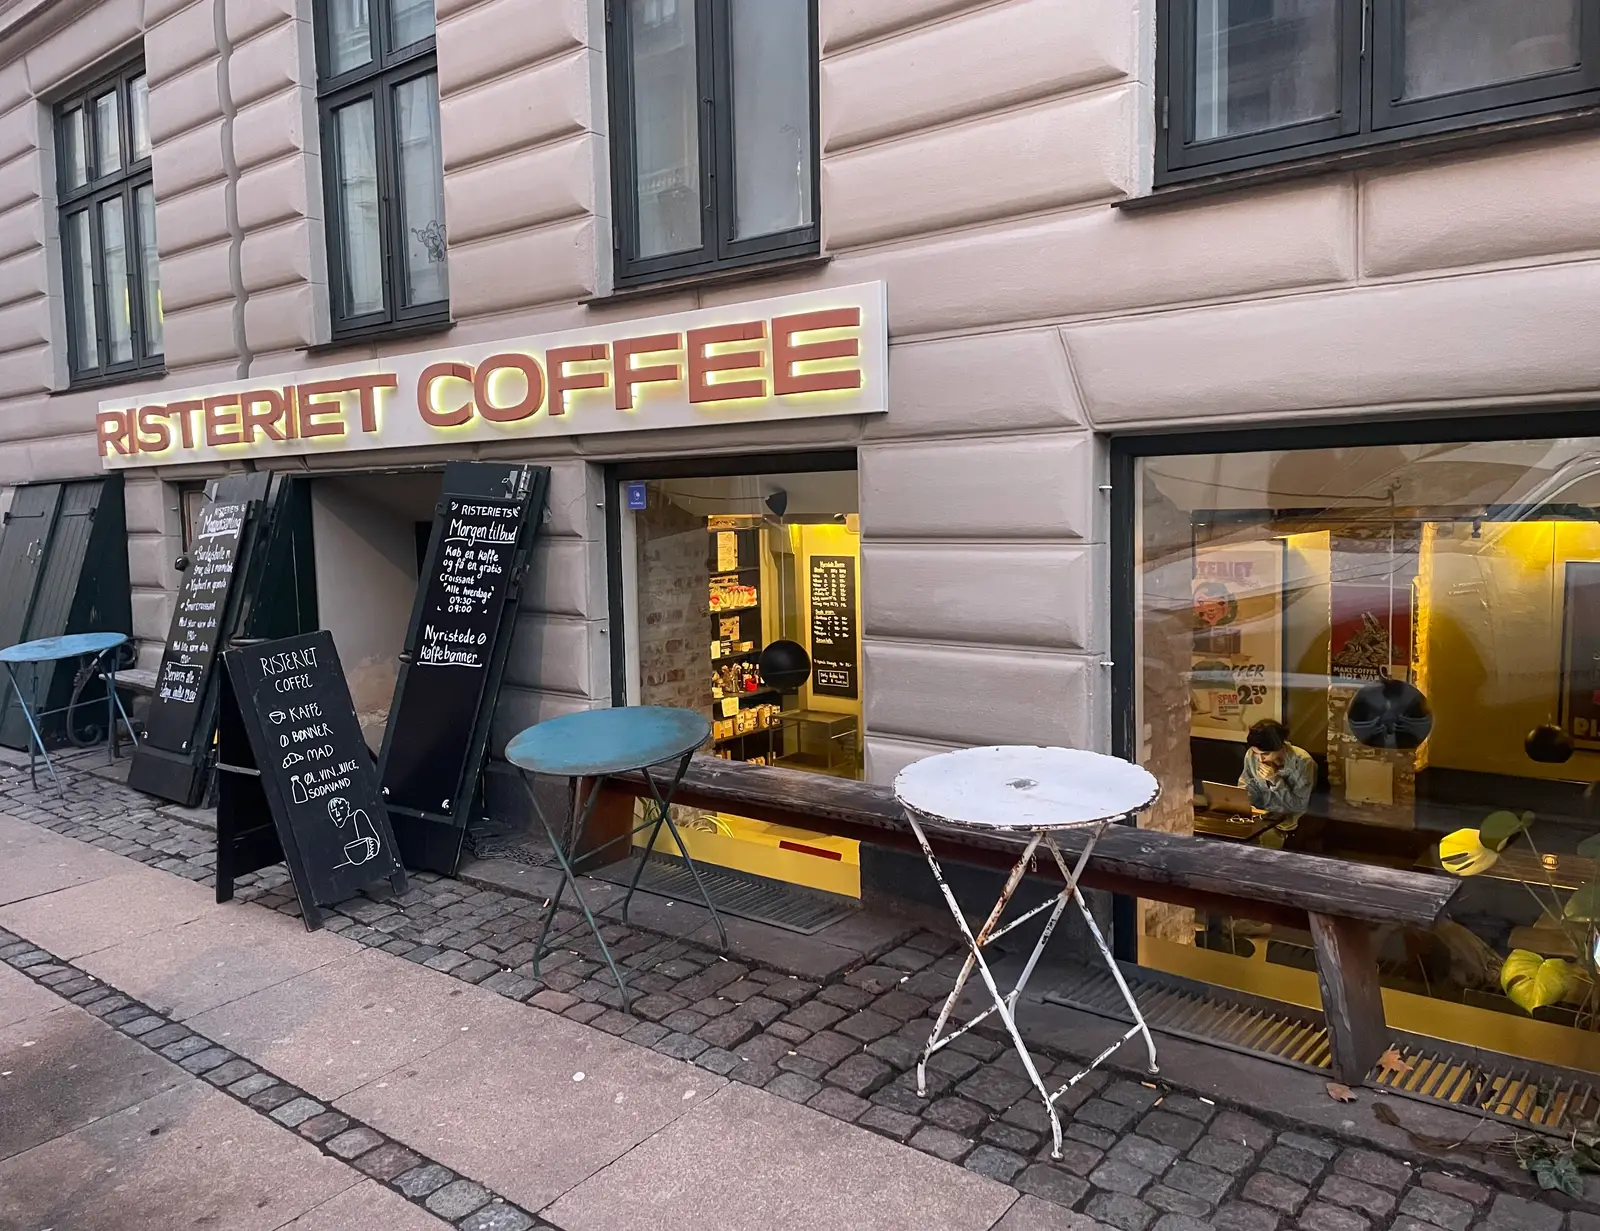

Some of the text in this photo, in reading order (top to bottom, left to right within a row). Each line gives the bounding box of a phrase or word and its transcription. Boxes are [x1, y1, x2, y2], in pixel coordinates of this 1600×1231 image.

[96, 306, 861, 457] RISTERIET COFFEE
[461, 504, 513, 518] RISTERIETS
[464, 550, 475, 560] en
[443, 557, 502, 579] og få en gratis
[447, 604, 472, 613] 09:00
[424, 624, 476, 647] Nyristede
[260, 646, 318, 677] RISTERIET
[1353, 667, 1378, 675] COFFEE
[274, 673, 314, 693] COFFEE
[1340, 672, 1357, 680] NOT
[288, 702, 323, 723] KAFFE
[291, 722, 334, 743] BØNNER
[306, 744, 334, 762] MAD
[308, 777, 351, 799] SODAVAND
